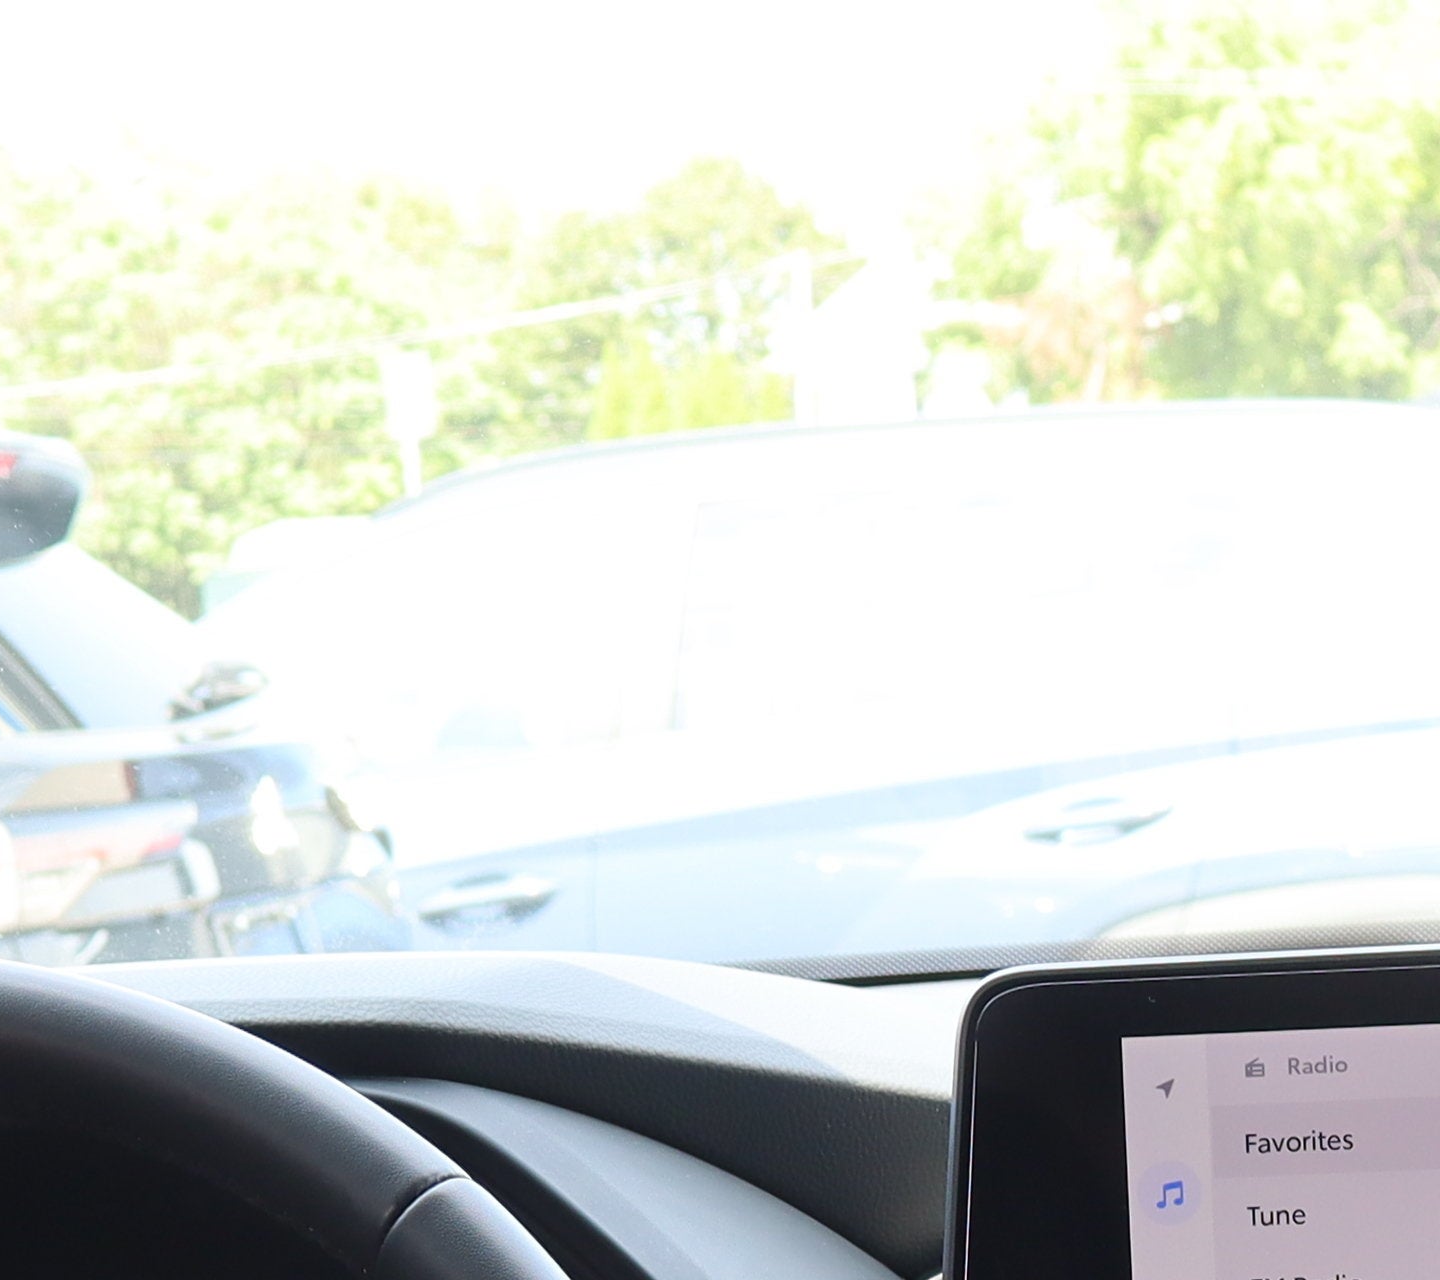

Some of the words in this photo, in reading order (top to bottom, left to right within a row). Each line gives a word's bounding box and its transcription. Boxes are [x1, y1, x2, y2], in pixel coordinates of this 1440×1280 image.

[1287, 1055, 1348, 1076] Radio
[1244, 1128, 1354, 1155] Favorites
[1247, 1203, 1307, 1228] Tune
